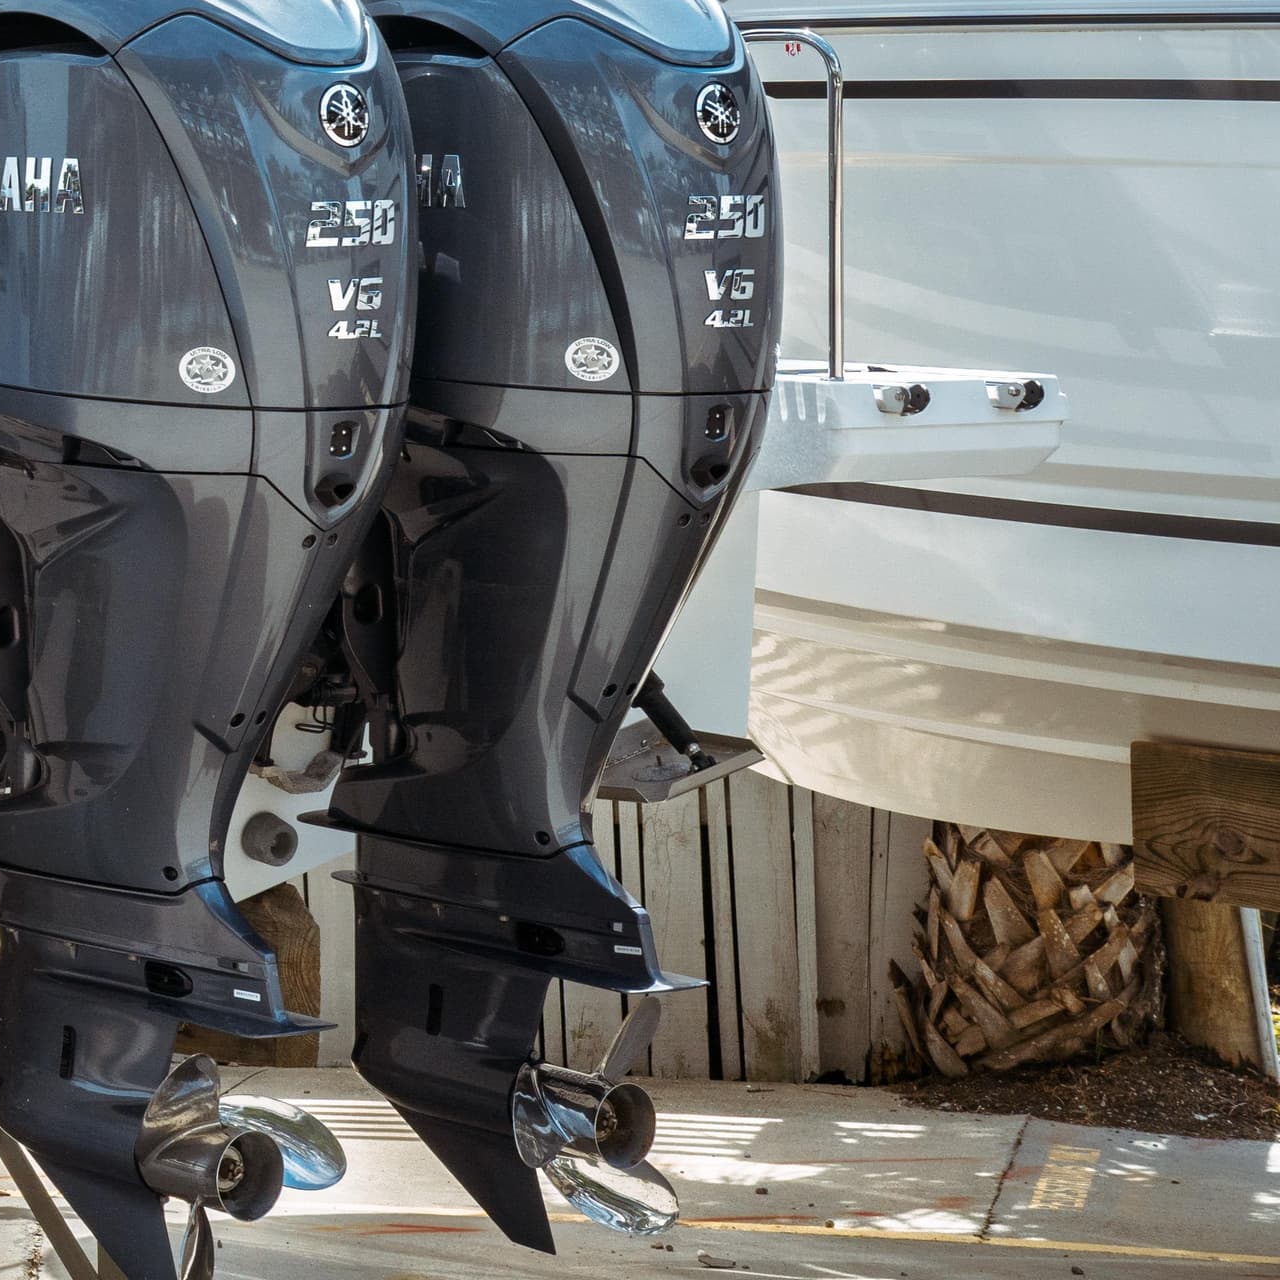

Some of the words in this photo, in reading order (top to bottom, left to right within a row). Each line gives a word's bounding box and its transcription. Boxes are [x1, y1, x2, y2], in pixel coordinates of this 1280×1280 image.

[306, 200, 396, 248] 250
[684, 195, 766, 240] 250
[328, 277, 384, 311] V6
[704, 269, 756, 301] V6
[328, 320, 383, 339] 4.2L
[704, 310, 755, 328] 4.2L
